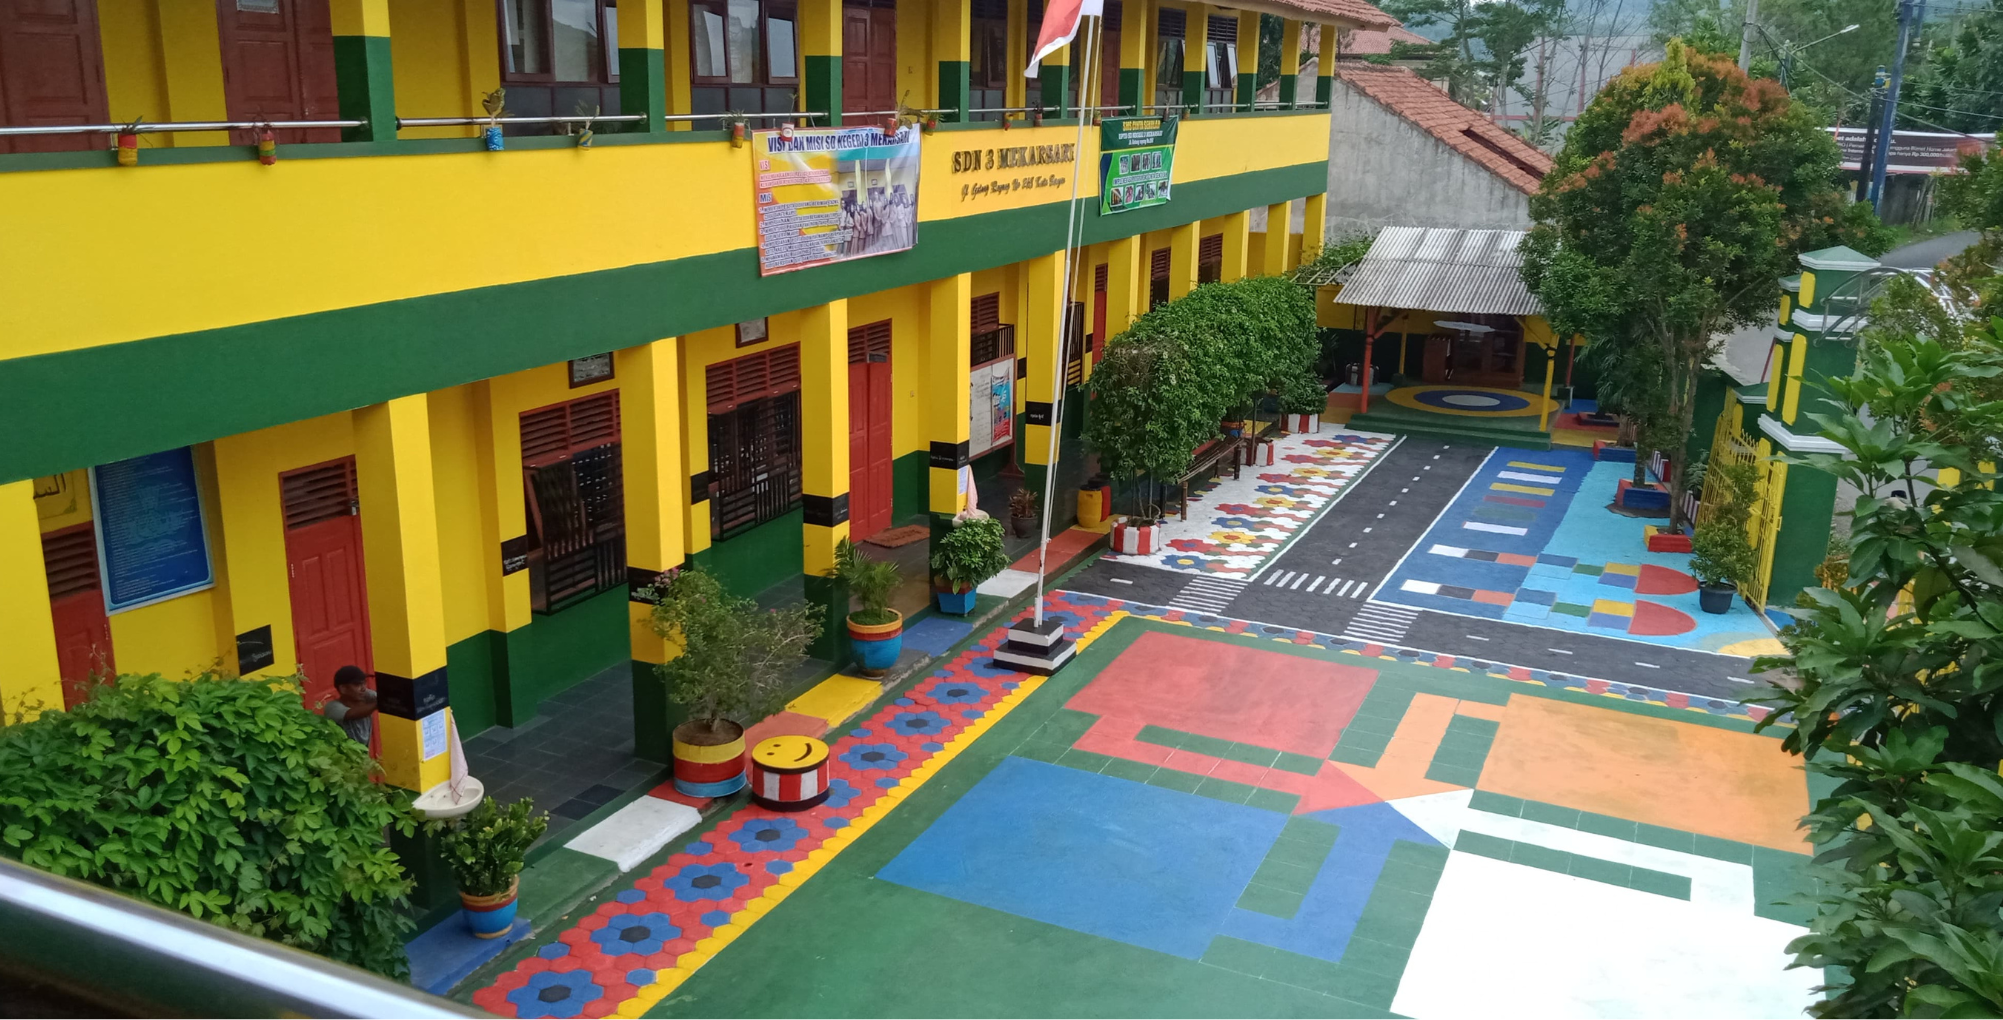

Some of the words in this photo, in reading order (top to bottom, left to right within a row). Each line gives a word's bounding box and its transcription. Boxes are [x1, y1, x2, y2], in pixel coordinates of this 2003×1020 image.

[768, 136, 785, 152] VISI
[788, 135, 804, 151] DAN
[806, 135, 823, 150] MISI
[825, 135, 837, 149] SD
[838, 133, 863, 148] NEGERI
[864, 133, 869, 147] 3
[870, 131, 910, 147] MEKARSARI
[953, 150, 982, 174] SDN
[985, 149, 995, 171] 3
[997, 143, 1076, 169] MEKARSARI
